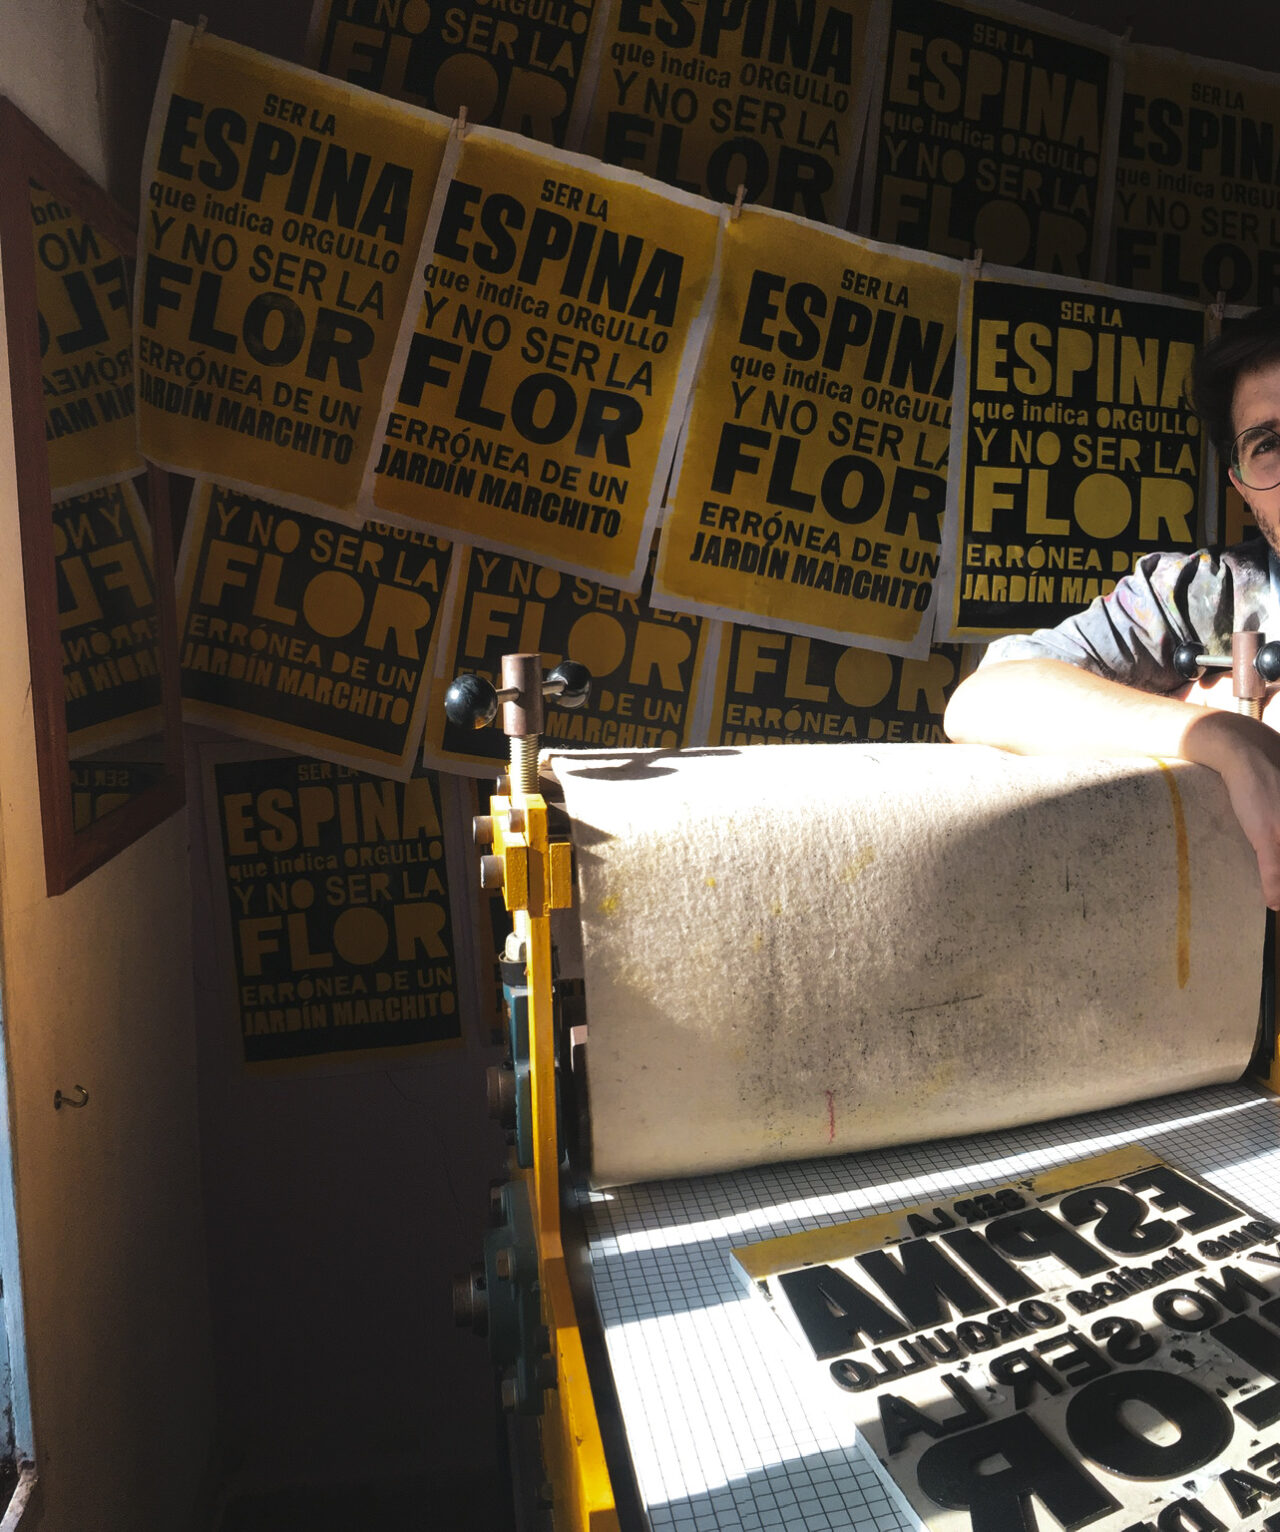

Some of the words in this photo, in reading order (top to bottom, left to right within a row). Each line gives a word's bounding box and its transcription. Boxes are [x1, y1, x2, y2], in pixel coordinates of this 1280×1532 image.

[441, 8, 520, 60] SER
[527, 31, 575, 79] LA
[973, 23, 1007, 51] SER
[1013, 33, 1033, 59] LA
[613, 67, 639, 106] Y
[643, 78, 698, 124] NO
[710, 94, 786, 139] SER
[796, 111, 840, 156] LA
[889, 26, 1100, 151] ESPINA
[1192, 82, 1222, 107] SER
[1226, 90, 1244, 111] LA
[159, 96, 413, 244] ESPINA
[540, 180, 583, 211] SER
[586, 193, 608, 222] LA
[149, 183, 196, 212] que
[204, 193, 274, 237] indica
[282, 219, 401, 272] ORGULLO
[151, 210, 175, 250] Y
[182, 224, 239, 272] NO
[248, 245, 327, 301] SER
[335, 272, 383, 317] LA
[433, 179, 684, 327] ESPINA
[143, 254, 375, 392] FLOR
[423, 264, 469, 292] que
[476, 275, 549, 319] indica
[557, 302, 669, 353] ORGULLO
[840, 269, 881, 300] SER
[885, 282, 907, 309] LA
[1061, 301, 1095, 324] SER
[1101, 306, 1122, 328] LA
[424, 290, 448, 329] Y
[453, 304, 511, 351] NO
[521, 327, 600, 381] SER
[605, 352, 652, 395] LA
[398, 332, 643, 468] FLOR
[972, 401, 1015, 423] que
[1024, 399, 1089, 426] indica
[1096, 407, 1200, 435] ORGULLO
[385, 412, 529, 476] ERRÓNEA
[540, 459, 581, 492] DE
[588, 472, 628, 504] UN
[711, 421, 947, 543] FLOR
[974, 426, 997, 460] Y
[1010, 429, 1061, 465] NO
[1071, 434, 1141, 471] SER
[1154, 442, 1196, 475] LA
[374, 444, 477, 498] JARDÍN
[478, 474, 621, 538] MARCHITO
[974, 464, 1192, 544] FLOR
[689, 531, 790, 580] JARDÍN
[792, 555, 930, 611] MARCHITO
[698, 501, 840, 556] ERRÓNEA
[851, 538, 891, 569] DE
[901, 548, 940, 579] UN
[965, 539, 1103, 572] ERRÓNEA
[200, 538, 427, 658] FLOR
[961, 571, 1054, 605] JARDÍN
[180, 640, 275, 688] JARDÍN
[275, 665, 407, 722] MARCHITO
[190, 612, 321, 667] ERRÓNEA
[331, 652, 370, 680] DE
[377, 663, 417, 693] UN
[735, 629, 954, 715] FLOR
[225, 778, 440, 854] ESPINA
[228, 862, 267, 882] que
[274, 852, 337, 873] indica
[344, 841, 443, 868] ORGULLO
[233, 884, 255, 915] Y
[266, 879, 315, 911] NO
[326, 871, 393, 905] SER
[402, 868, 444, 900] LA
[238, 901, 446, 977] FLOR
